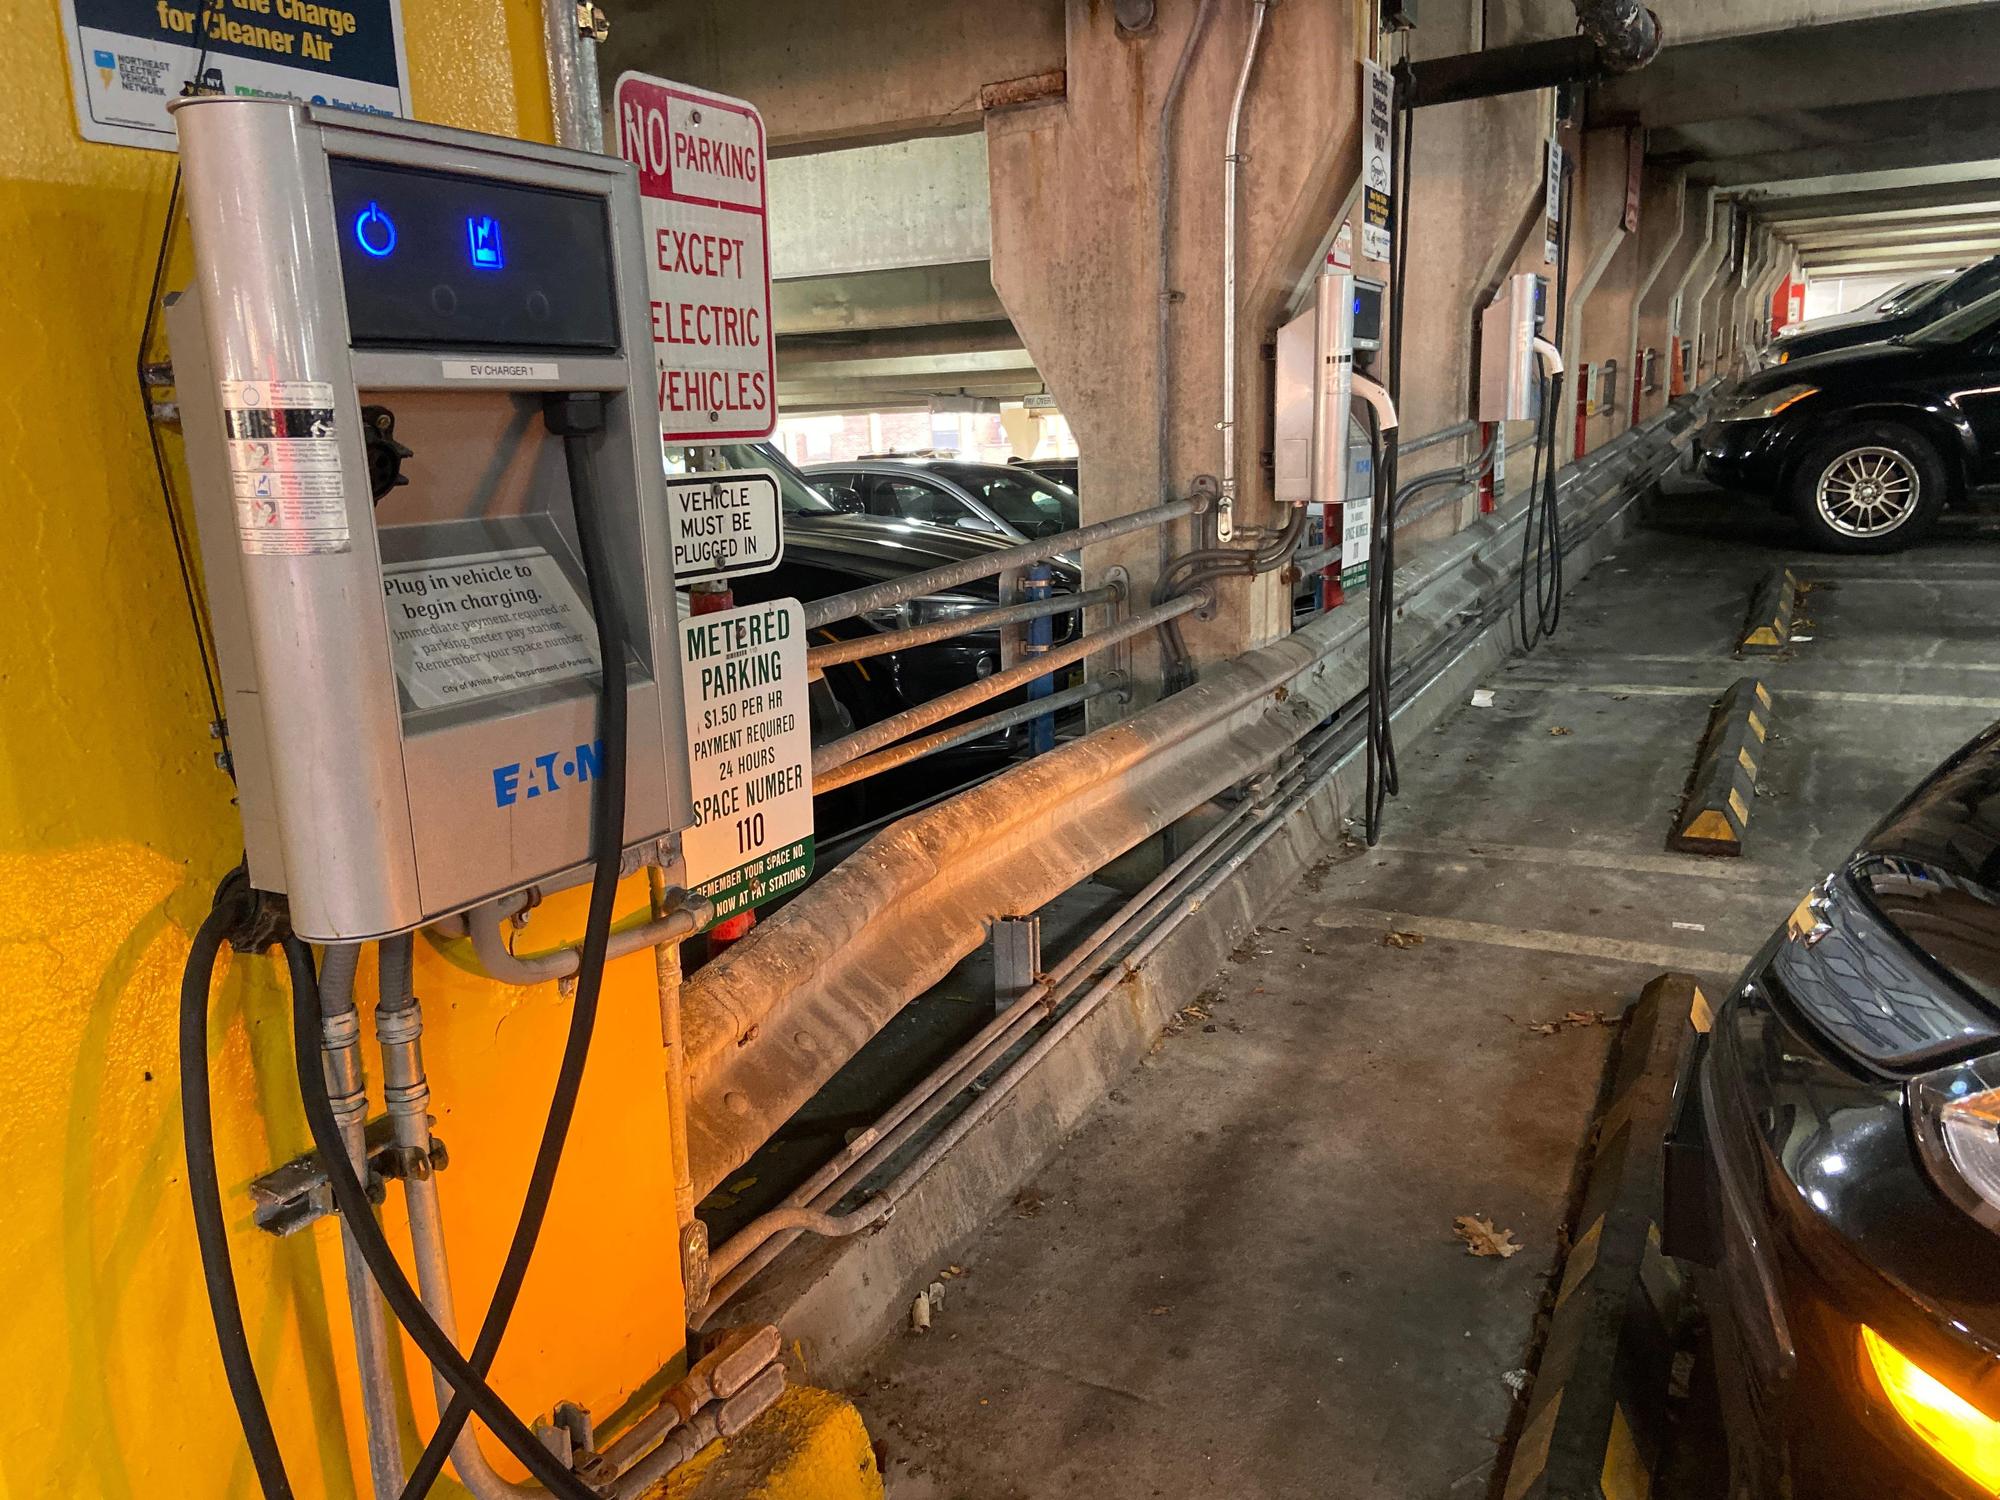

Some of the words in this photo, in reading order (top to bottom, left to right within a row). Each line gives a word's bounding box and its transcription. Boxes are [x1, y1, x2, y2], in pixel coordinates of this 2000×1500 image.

[157, 0, 196, 33] for
[203, 10, 295, 54] Cleaner
[301, 32, 335, 62] Air
[118, 54, 170, 72] NORTHEAST
[119, 64, 161, 79] ELECTRIC
[120, 73, 157, 86] VEHICLE
[122, 82, 167, 96] NETWORK
[623, 102, 668, 176] NO
[674, 131, 757, 183] PARKING
[656, 229, 744, 279] EXCEPT
[651, 300, 761, 347] ELECTRIC
[470, 365, 482, 375] EV
[485, 365, 528, 376] CHARGER
[530, 367, 534, 376] 1
[658, 371, 766, 412] VEHICLES
[679, 487, 750, 513] VEHICLE
[681, 515, 724, 539] MUST
[732, 511, 752, 532] BE
[674, 538, 738, 566] PLUGGED
[744, 535, 757, 555] IN
[384, 578, 428, 596] Plug
[428, 574, 449, 590] in
[451, 566, 513, 587] vehicle
[515, 564, 532, 578] to
[402, 599, 457, 620] begin
[460, 588, 542, 610] charging.
[392, 622, 460, 644] Immediate
[461, 613, 512, 632] payment
[511, 606, 559, 623] required
[559, 603, 571, 614] at
[687, 608, 790, 662] METERED
[414, 652, 483, 674] Remember
[485, 647, 510, 663] your
[511, 642, 544, 656] space
[421, 638, 471, 657] parking
[470, 631, 503, 645] meter
[506, 629, 526, 643] pay
[442, 683, 459, 694] City
[459, 681, 467, 690] of
[467, 677, 493, 689] White
[492, 672, 515, 683] Plains
[515, 663, 559, 678] Department
[558, 661, 567, 670] of
[567, 656, 594, 667] Parking
[701, 650, 782, 701] PARKING
[704, 702, 737, 729] $1.50
[742, 695, 763, 718] PER
[768, 689, 783, 710] HR
[694, 729, 742, 762] PAYMENT
[747, 713, 795, 745] REQUIRED
[719, 760, 733, 781] 24
[738, 746, 775, 775] HOURS
[693, 786, 740, 828] SPACE
[746, 764, 803, 808] NUMBER
[736, 812, 765, 854] 110
[744, 860, 764, 881] YOUR
[767, 851, 791, 871] SPACE
[792, 843, 806, 861] NO.
[716, 898, 736, 918] NOW
[739, 889, 748, 907] AT
[751, 880, 766, 901] PAY
[769, 865, 806, 893] STATIONS
